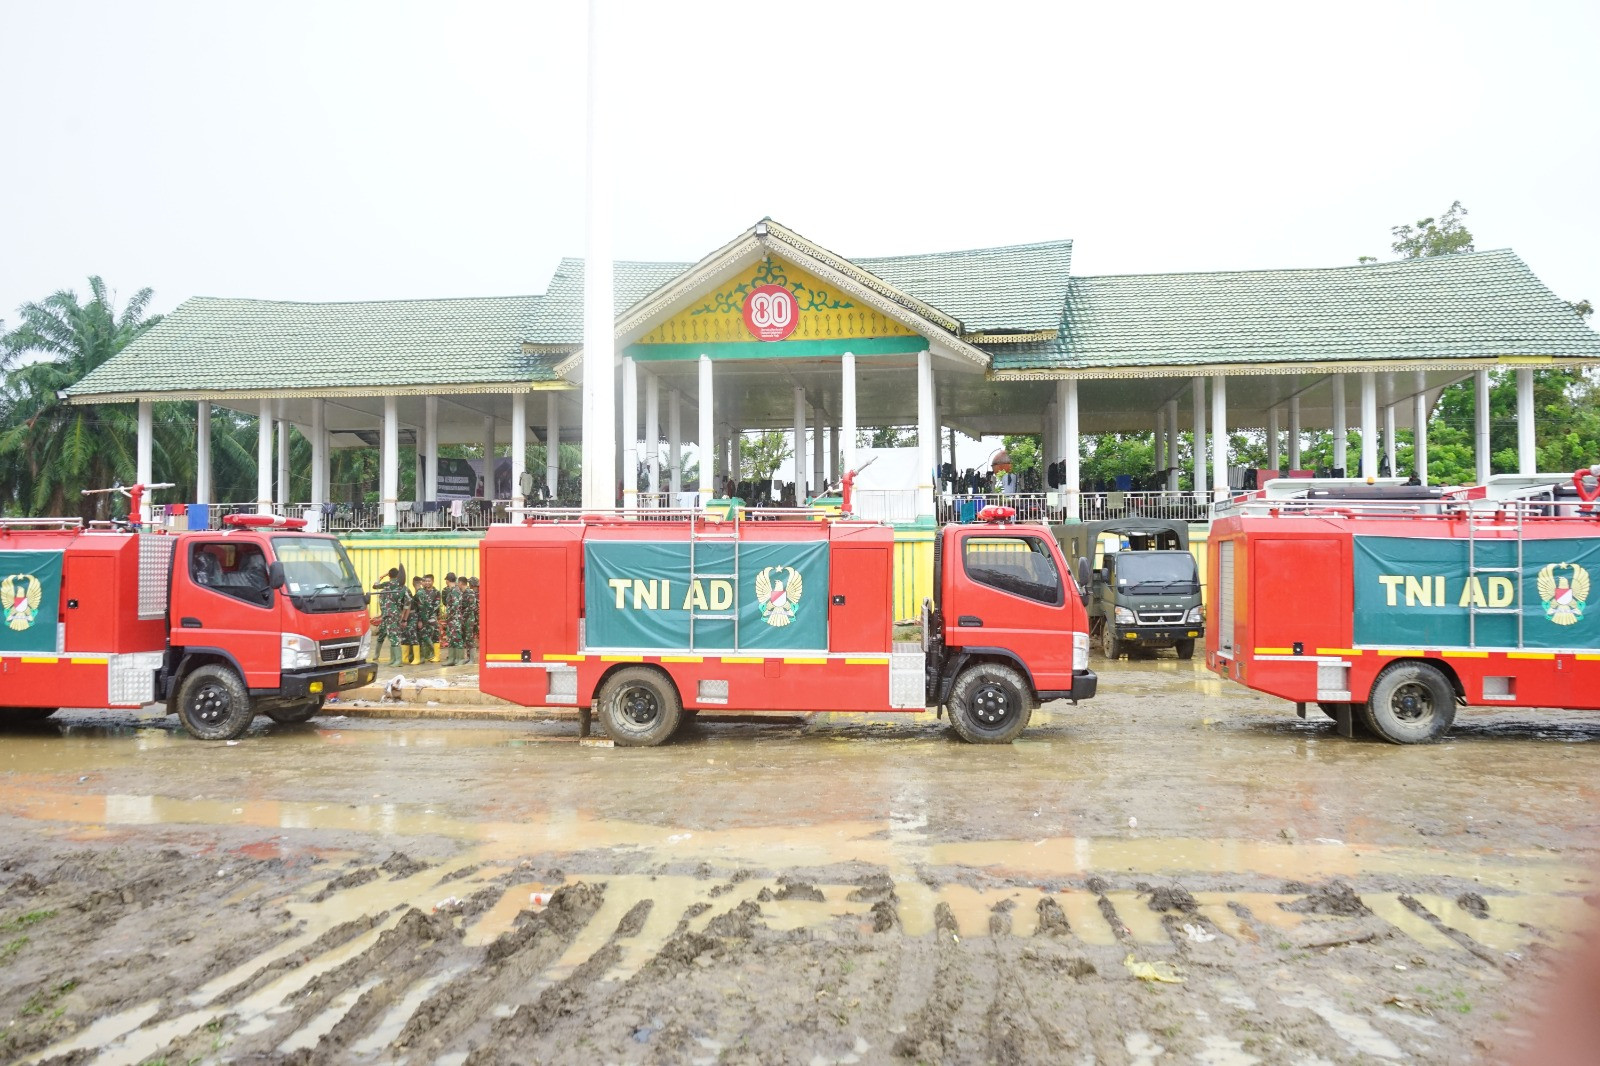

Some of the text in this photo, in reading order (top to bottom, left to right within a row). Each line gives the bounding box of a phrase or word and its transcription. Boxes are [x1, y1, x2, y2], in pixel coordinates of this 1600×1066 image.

[751, 292, 791, 327] 80
[609, 578, 733, 610] TNI AD
[1379, 575, 1514, 608] TNI AD
